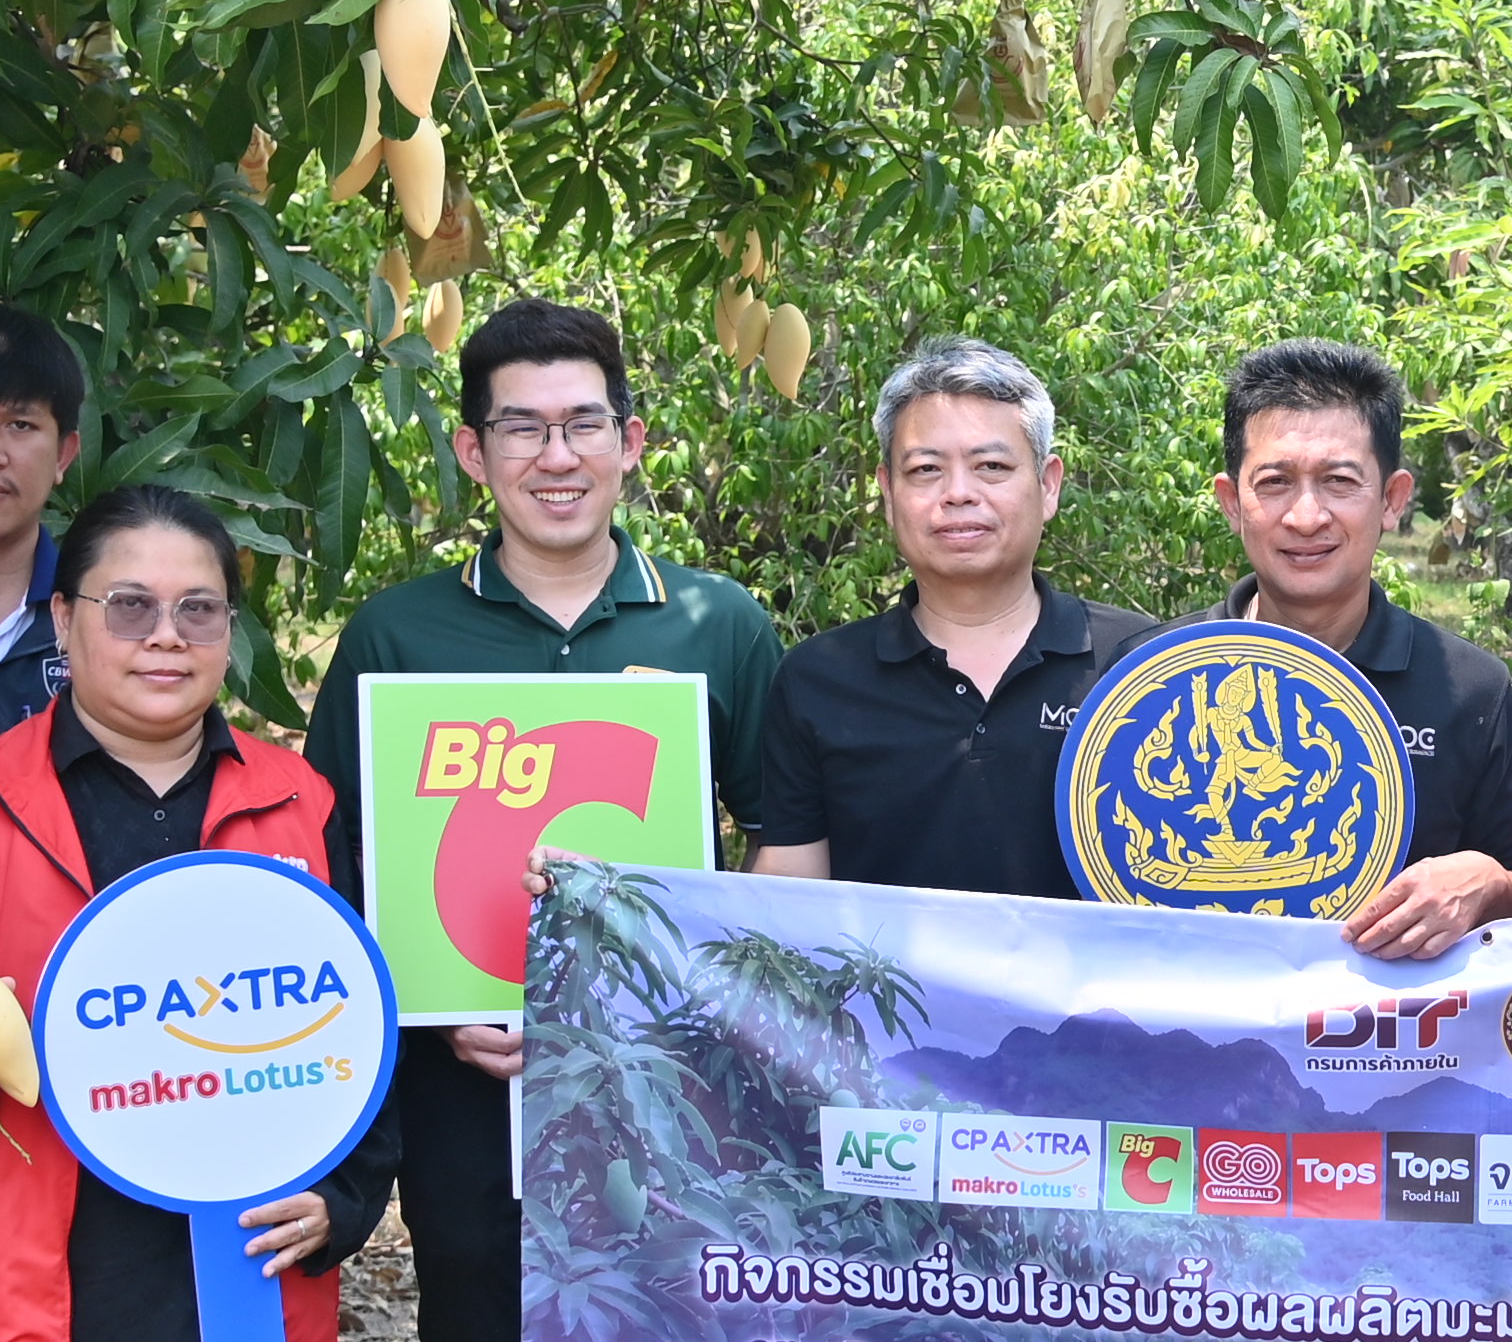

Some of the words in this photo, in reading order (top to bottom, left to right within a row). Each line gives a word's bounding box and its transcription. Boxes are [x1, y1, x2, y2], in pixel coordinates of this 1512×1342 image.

[424, 724, 556, 809] Big
[434, 720, 659, 985] C
[76, 984, 147, 1030] CP
[156, 960, 349, 1022] AXTRA
[1307, 1054, 1459, 1072] กรมการค้าภายใน
[89, 1069, 221, 1113] makro
[225, 1055, 353, 1096] Lotus's
[836, 1130, 918, 1172] AFC
[951, 1128, 987, 1150] CP
[991, 1131, 1091, 1155] AXTRA
[1121, 1134, 1155, 1158] Big
[1122, 1136, 1182, 1204] C
[1203, 1141, 1282, 1186] GO
[1297, 1158, 1376, 1191] Tops
[1391, 1151, 1470, 1186] Tops
[952, 1176, 1018, 1194] makro
[1021, 1180, 1087, 1198] Lotus's
[1211, 1186, 1274, 1200] WHOLESALE
[1402, 1190, 1432, 1202] Food
[1434, 1190, 1460, 1203] Hall
